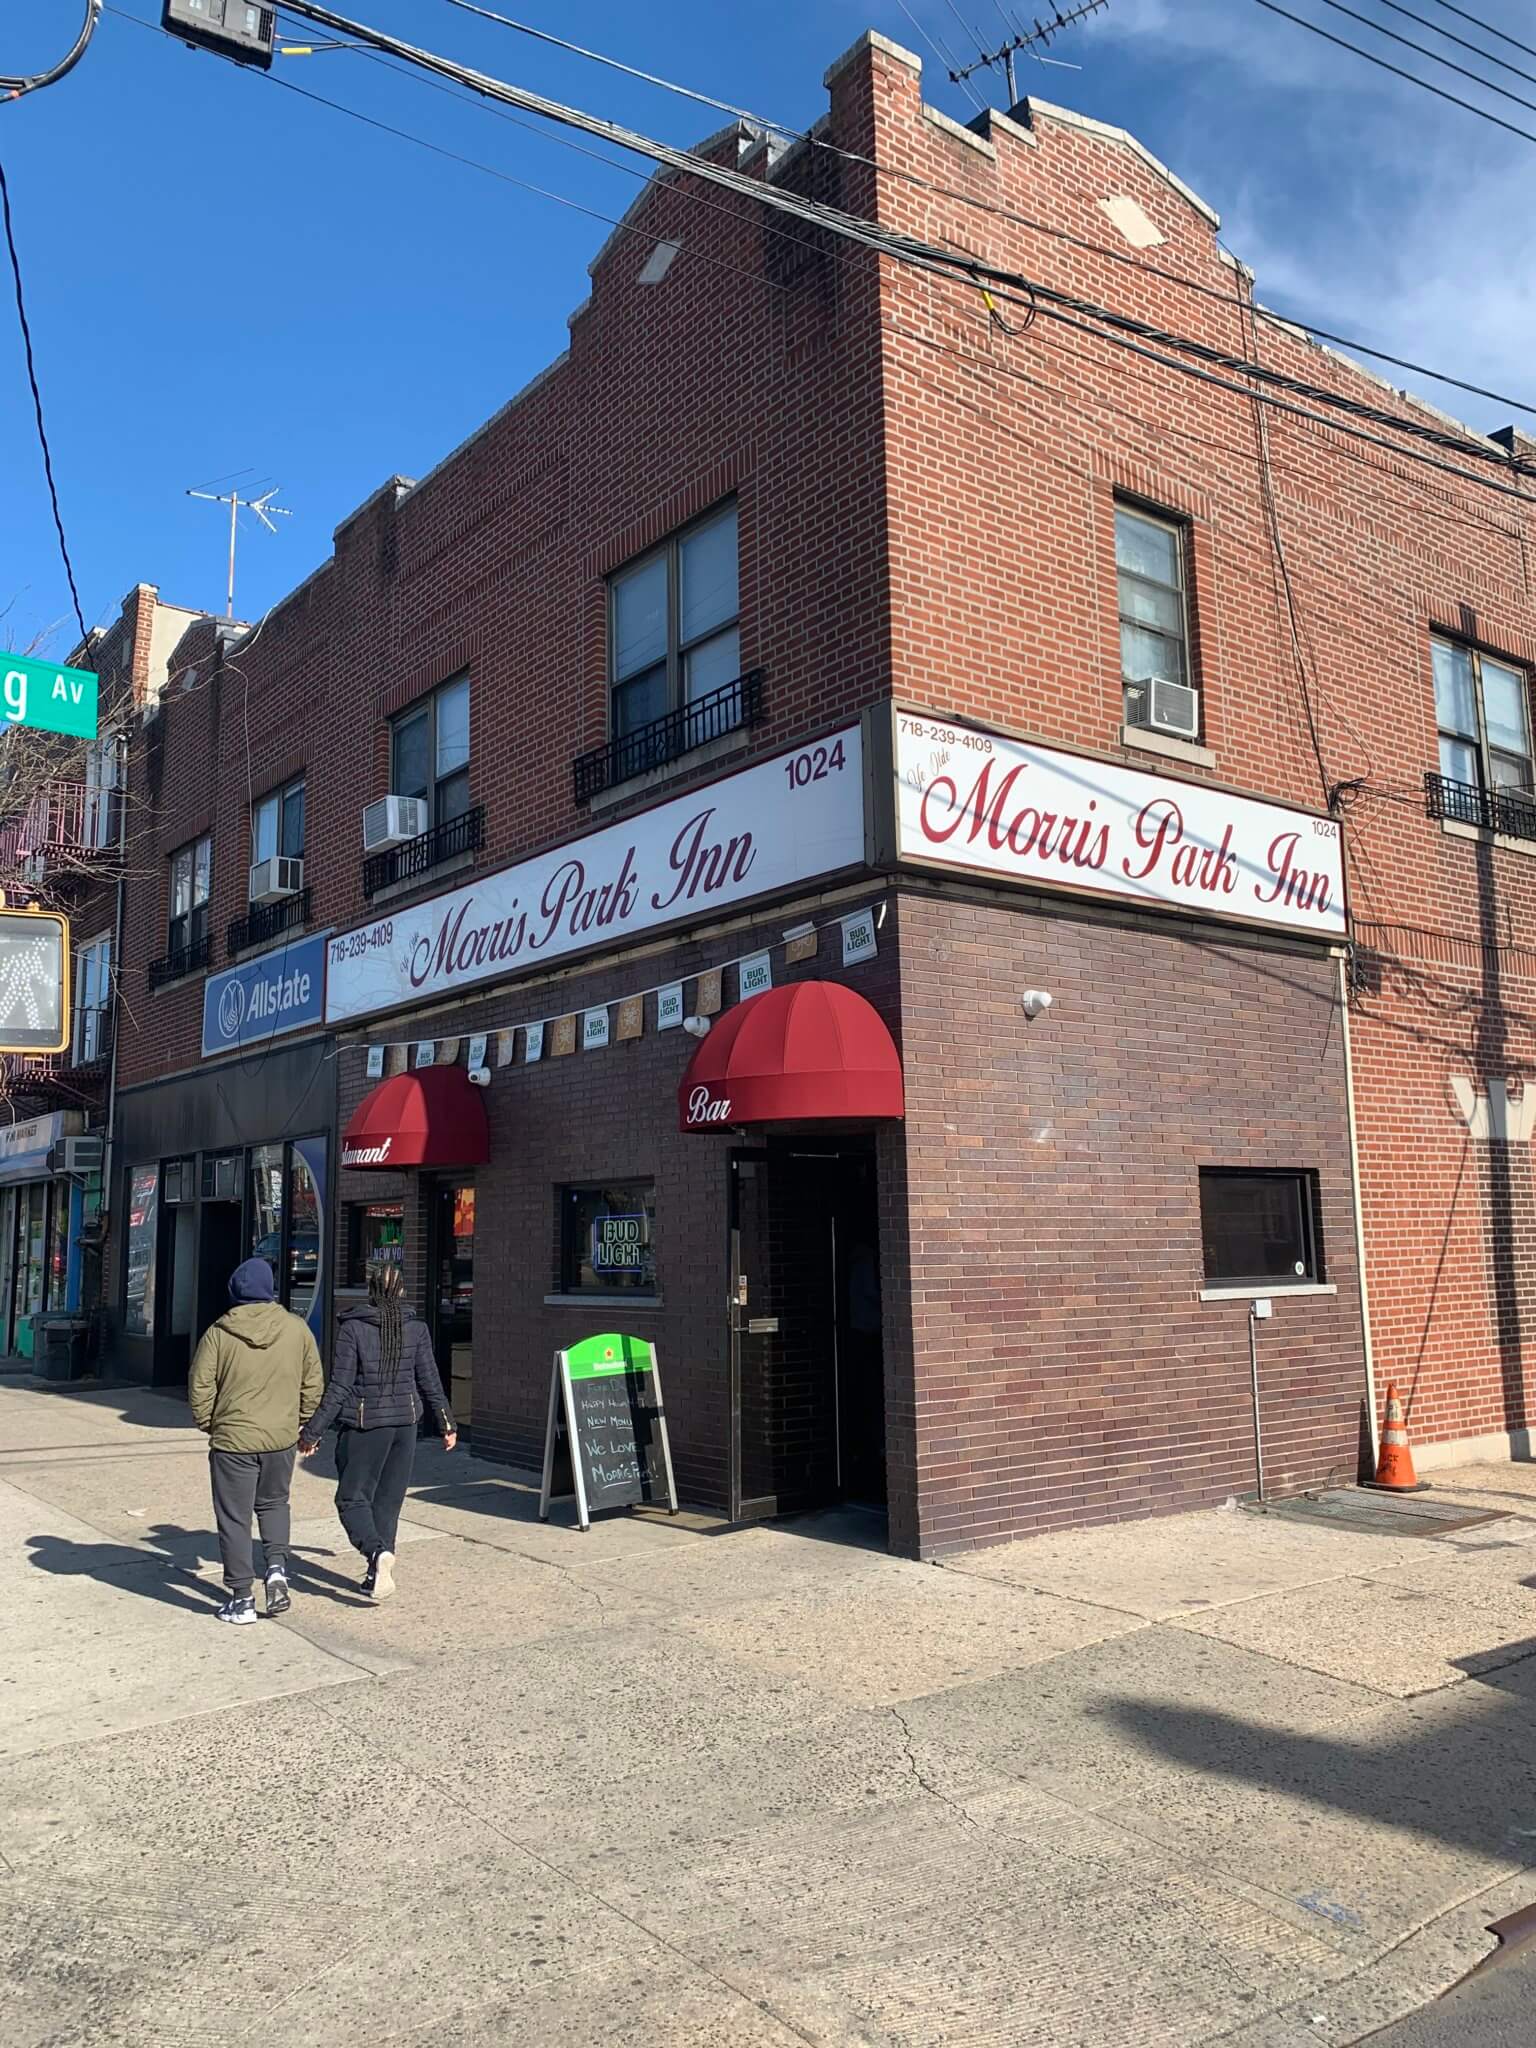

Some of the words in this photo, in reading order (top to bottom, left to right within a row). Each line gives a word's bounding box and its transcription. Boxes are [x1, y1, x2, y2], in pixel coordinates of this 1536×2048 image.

[51, 673, 84, 705] Av
[899, 718, 993, 754] 718-239-4109
[784, 739, 847, 791] 1024
[919, 757, 1110, 871] Morris
[1122, 798, 1240, 895] Park
[1254, 832, 1333, 914] Inn
[1311, 820, 1338, 840] 1024
[409, 898, 528, 988] Morris
[529, 846, 640, 949] Park
[650, 807, 758, 910] Inn
[330, 921, 393, 965] 718-239-4109
[847, 934, 871, 951] LIGHT
[849, 925, 867, 941] BUD
[743, 974, 768, 990] LIGHT
[746, 967, 764, 980] BUD
[246, 969, 310, 1022] Allstate
[662, 998, 677, 1009] BUD
[660, 1005, 680, 1017] LIGHT
[586, 1026, 607, 1038] LIGHT
[589, 1020, 604, 1031] BUD
[687, 1086, 731, 1123] Bar
[603, 1220, 639, 1243] BUD
[373, 1247, 390, 1261] NEW
